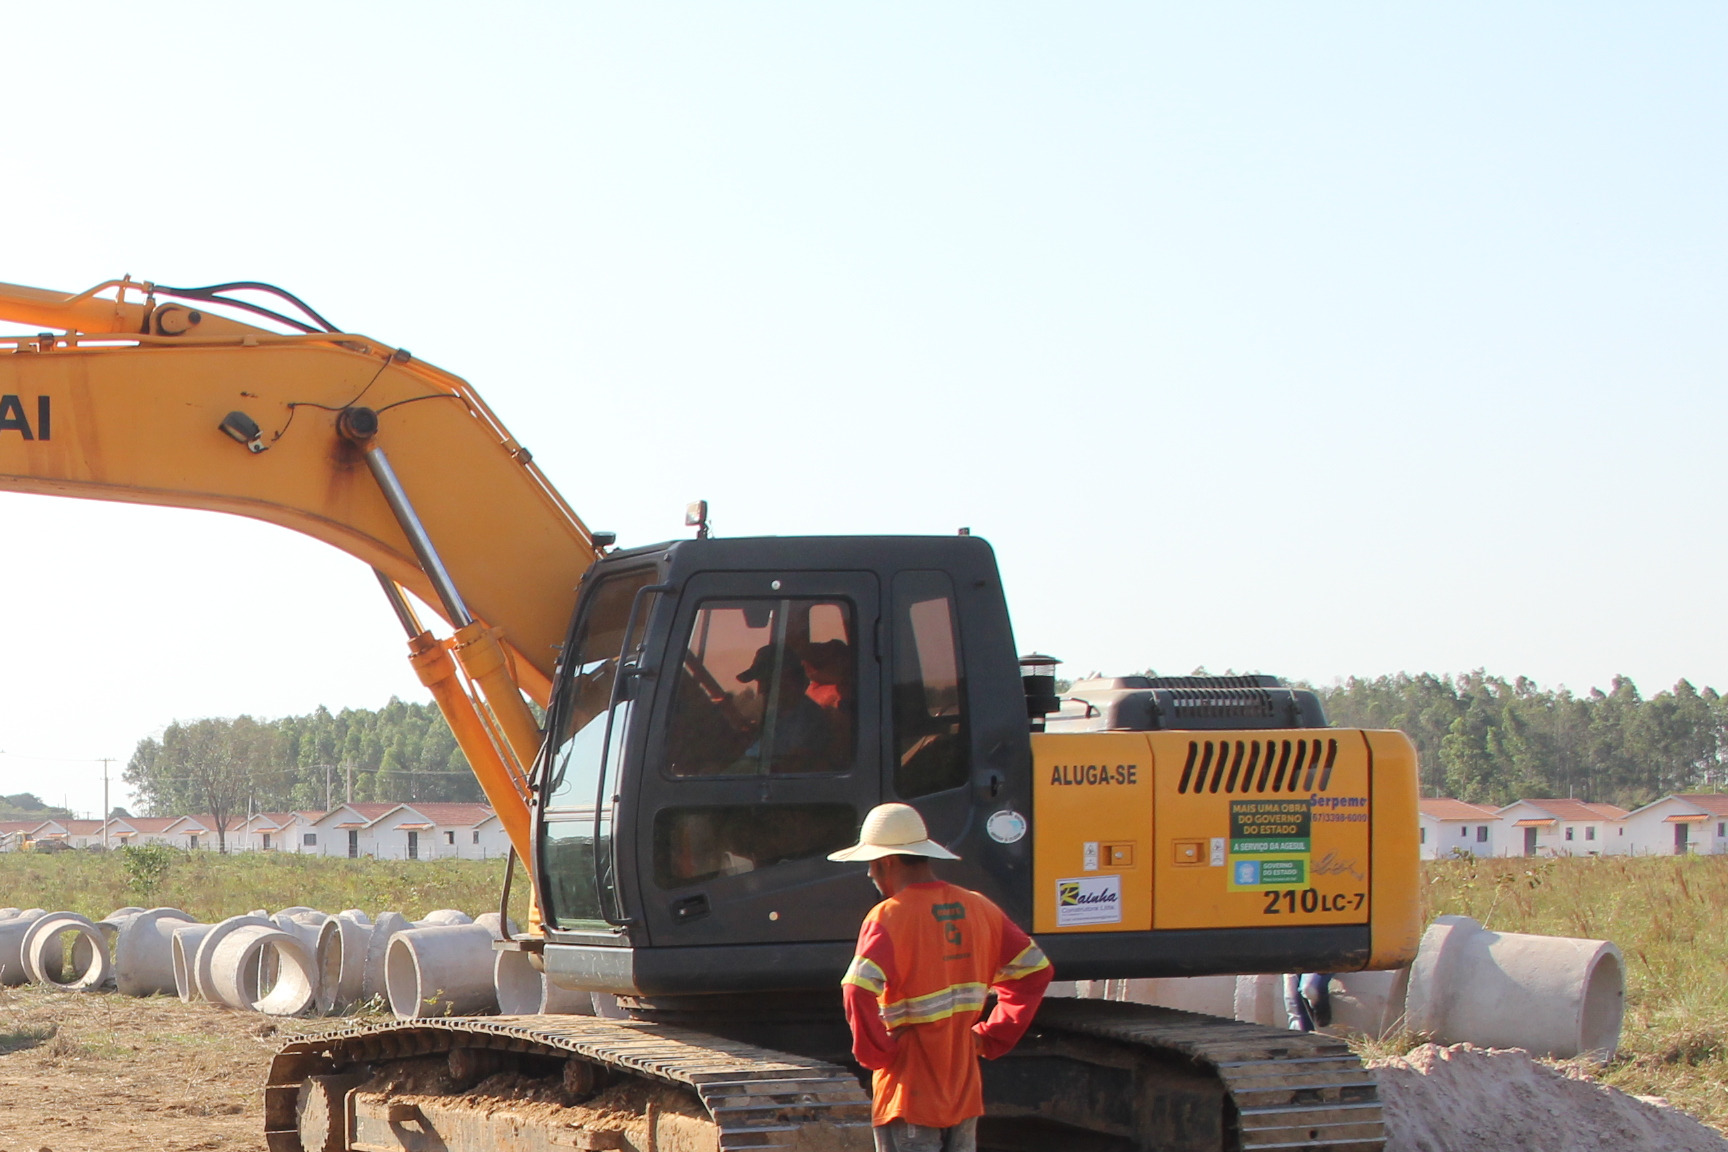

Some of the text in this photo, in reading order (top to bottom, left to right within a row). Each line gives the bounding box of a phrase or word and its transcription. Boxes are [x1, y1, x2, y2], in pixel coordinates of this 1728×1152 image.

[1051, 764, 1137, 786] ALUGA-SE
[1233, 803, 1308, 813] MAIS UMA OBRA
[1238, 814, 1302, 824] DO GOVERNO
[1243, 825, 1297, 834] DO ESTADO
[1234, 843, 1240, 851] A
[1240, 842, 1268, 852] SERVIÇO
[1269, 842, 1280, 850] DA
